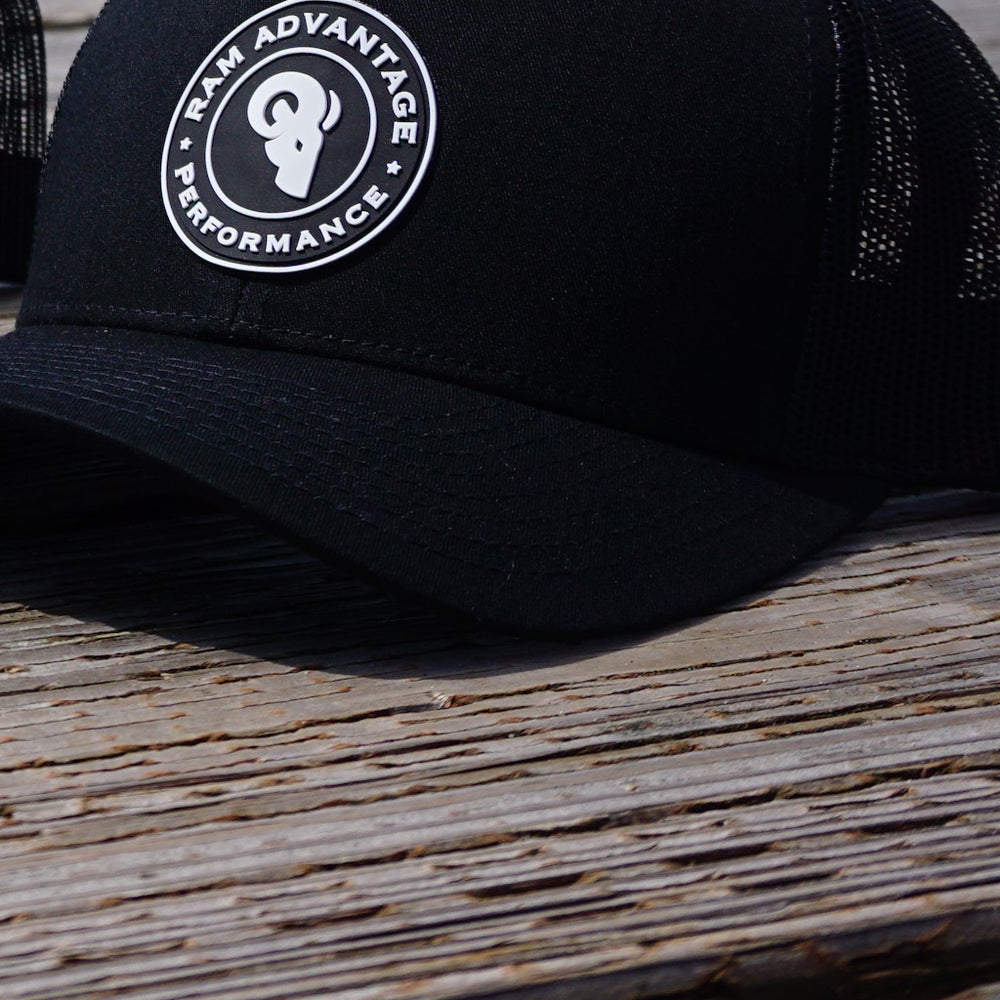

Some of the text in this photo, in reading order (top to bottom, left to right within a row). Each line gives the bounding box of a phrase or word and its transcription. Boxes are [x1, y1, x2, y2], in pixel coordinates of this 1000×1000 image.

[184, 12, 418, 145] RAM ADVANTAGE
[174, 162, 390, 253] PERFORMANCE
